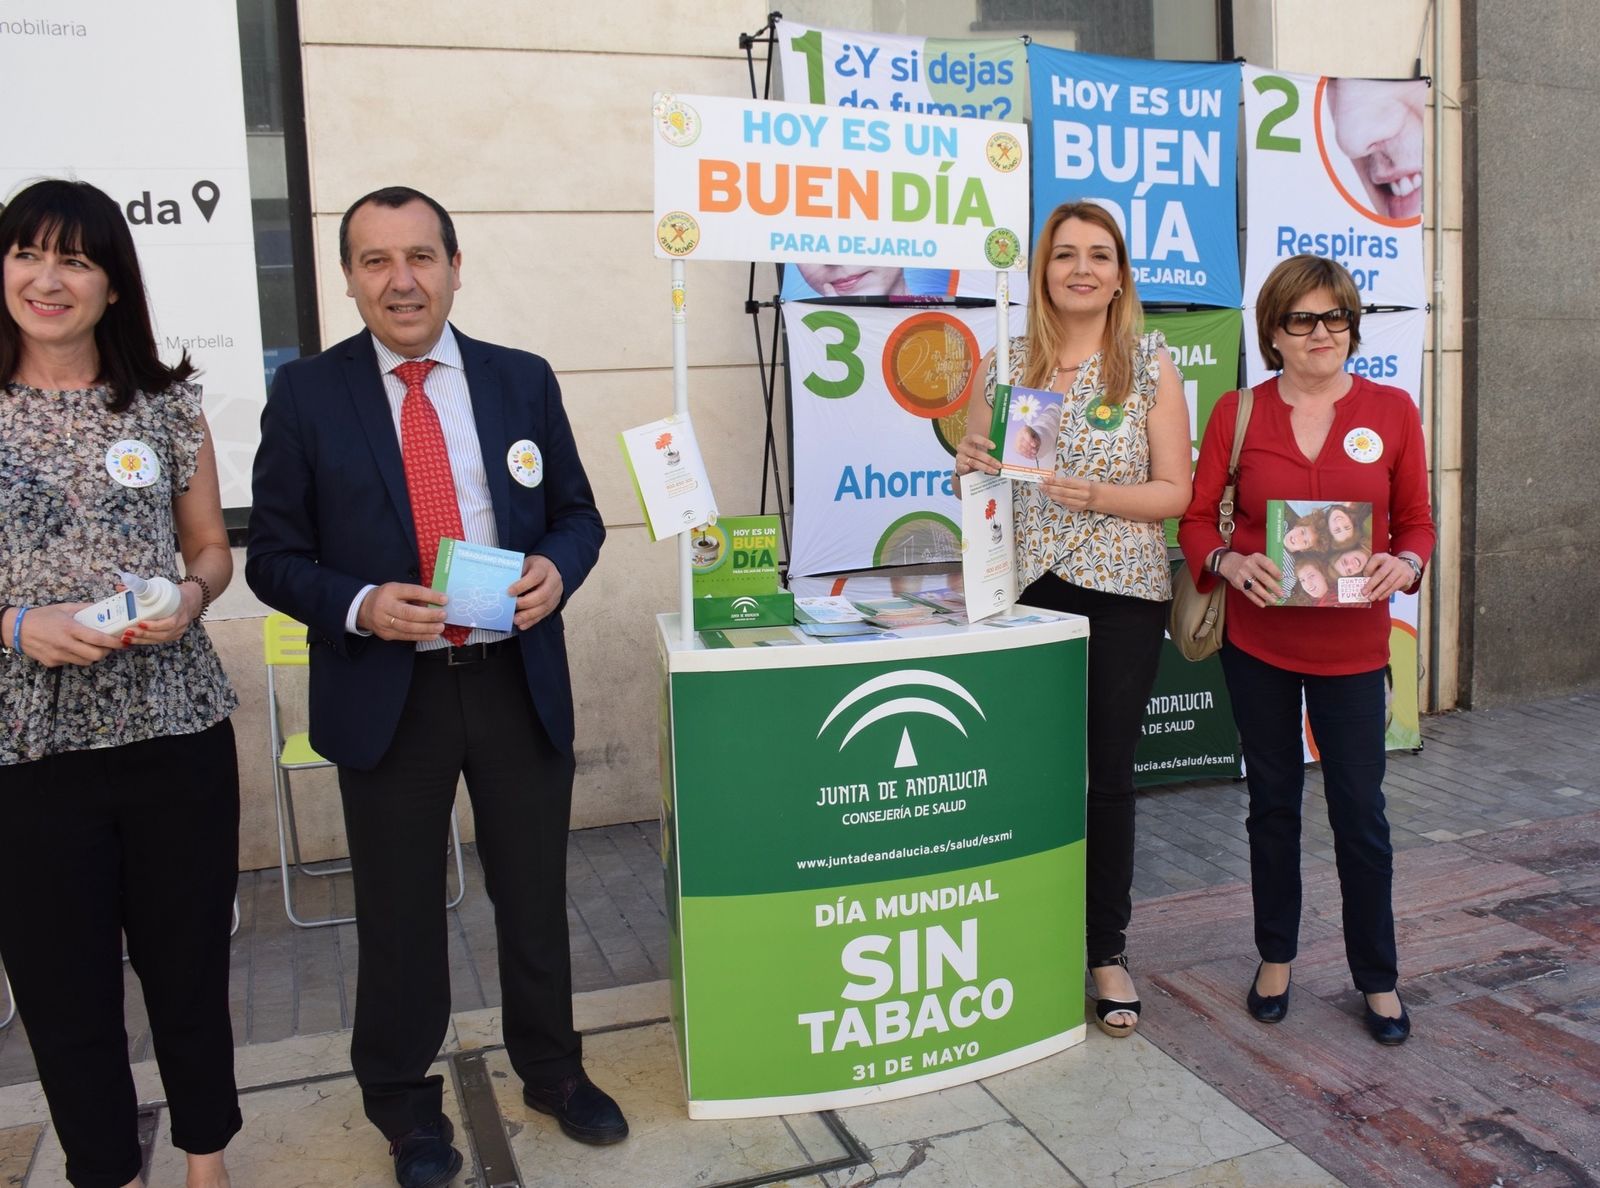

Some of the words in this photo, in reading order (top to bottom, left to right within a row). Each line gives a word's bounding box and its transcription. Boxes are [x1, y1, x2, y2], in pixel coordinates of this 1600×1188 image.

[791, 30, 826, 106] 1
[891, 49, 918, 83] si
[928, 52, 1014, 93] dejas
[1051, 74, 1121, 112] HOY
[1130, 86, 1170, 117] ES
[1179, 89, 1222, 118] UN
[1252, 75, 1301, 153] 2
[743, 110, 829, 148] HOY
[842, 118, 892, 153] ES
[904, 124, 959, 159] UN
[1053, 120, 1221, 188] BUEN
[698, 158, 880, 221] BUEN
[892, 161, 996, 228] DÍA
[770, 232, 831, 253] PARA
[838, 235, 938, 258] DEJARLO
[1276, 226, 1398, 260] Respiras
[166, 333, 234, 350] Marbella
[801, 310, 866, 399] 3
[1168, 344, 1217, 367] DIAL
[1344, 354, 1398, 378] reas
[733, 528, 751, 537] HOY
[752, 528, 762, 536] ES
[764, 527, 776, 536] UN
[733, 536, 776, 550] BUEN
[1149, 723, 1162, 735] DE
[1164, 720, 1195, 733] SALUD
[816, 783, 870, 806] JUNTA
[877, 780, 898, 801] DE
[906, 768, 988, 798] ANDALUCIA
[842, 804, 912, 826] CONSEJERÍA
[914, 804, 930, 818] DE
[932, 799, 967, 816] SALUD
[796, 829, 1013, 870] www.juntadeandalucia.es/salud/esxmi
[815, 896, 867, 928] DÍA
[876, 879, 999, 920] MUNDIAL
[840, 917, 978, 1002] SIN
[798, 977, 1014, 1055] TABACO
[852, 1063, 876, 1082] 31
[885, 1056, 914, 1076] DE
[922, 1041, 980, 1068] MAYO
